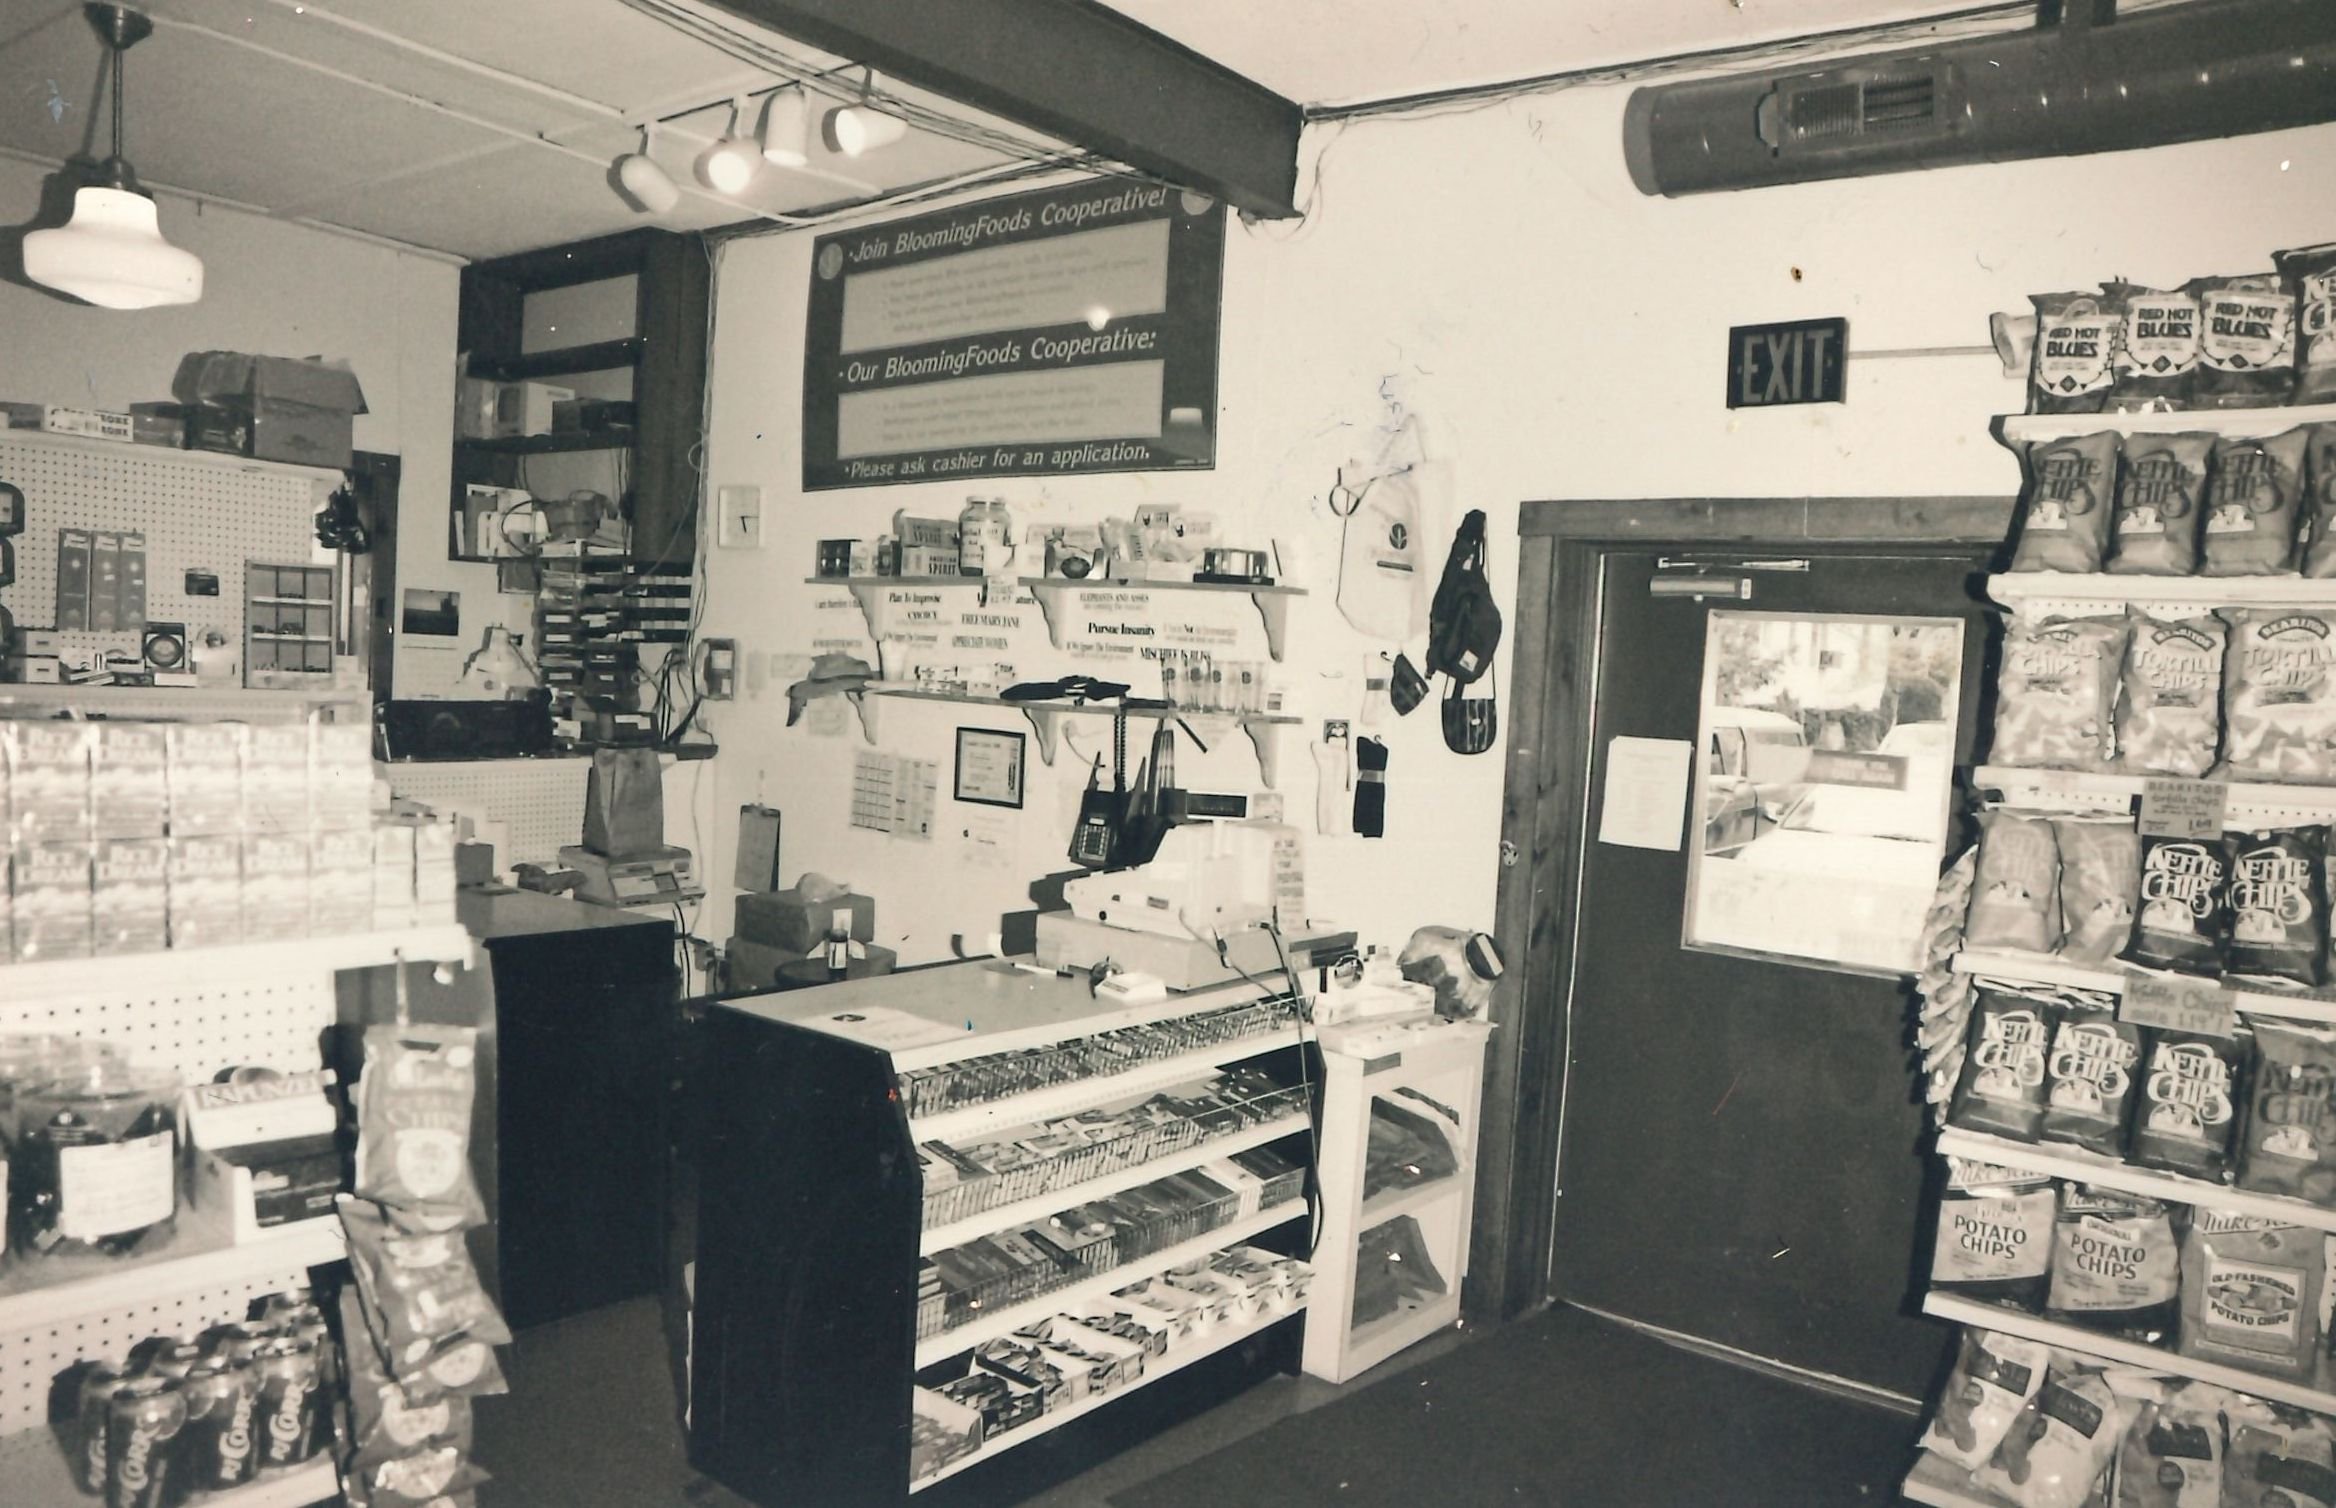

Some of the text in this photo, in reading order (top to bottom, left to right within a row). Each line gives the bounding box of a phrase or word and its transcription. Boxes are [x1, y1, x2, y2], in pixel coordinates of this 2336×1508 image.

[853, 187, 1168, 264] Join BloomingFoods Cooperative!
[2137, 308, 2195, 320] RED HOT
[2215, 302, 2278, 319] RED HOT
[2048, 327, 2102, 339] RED HOT
[2136, 322, 2193, 339] BLUES
[2212, 316, 2272, 339] BLUES
[847, 329, 1157, 385] Our BloomingFoods Cooperative:
[2046, 341, 2098, 358] BLUES
[1743, 328, 1836, 403] EXIT
[851, 440, 1150, 479] Please ask cashier for an application.
[929, 563, 957, 575] SPIRIT
[1088, 622, 1118, 635] Pursue
[1121, 623, 1156, 637] Insanity
[2053, 1022, 2138, 1066] KETTLE
[2050, 1052, 2131, 1099] CHIPS
[2147, 1071, 2234, 1126] CHIPS
[1955, 1214, 2028, 1245] POTATO
[1960, 1234, 2017, 1260] CHIPS
[2071, 1233, 2147, 1264] POTATO
[2076, 1253, 2138, 1280] CHIPS
[2212, 1273, 2233, 1283] OLD
[2211, 1301, 2290, 1326] POTATO CHIPS
